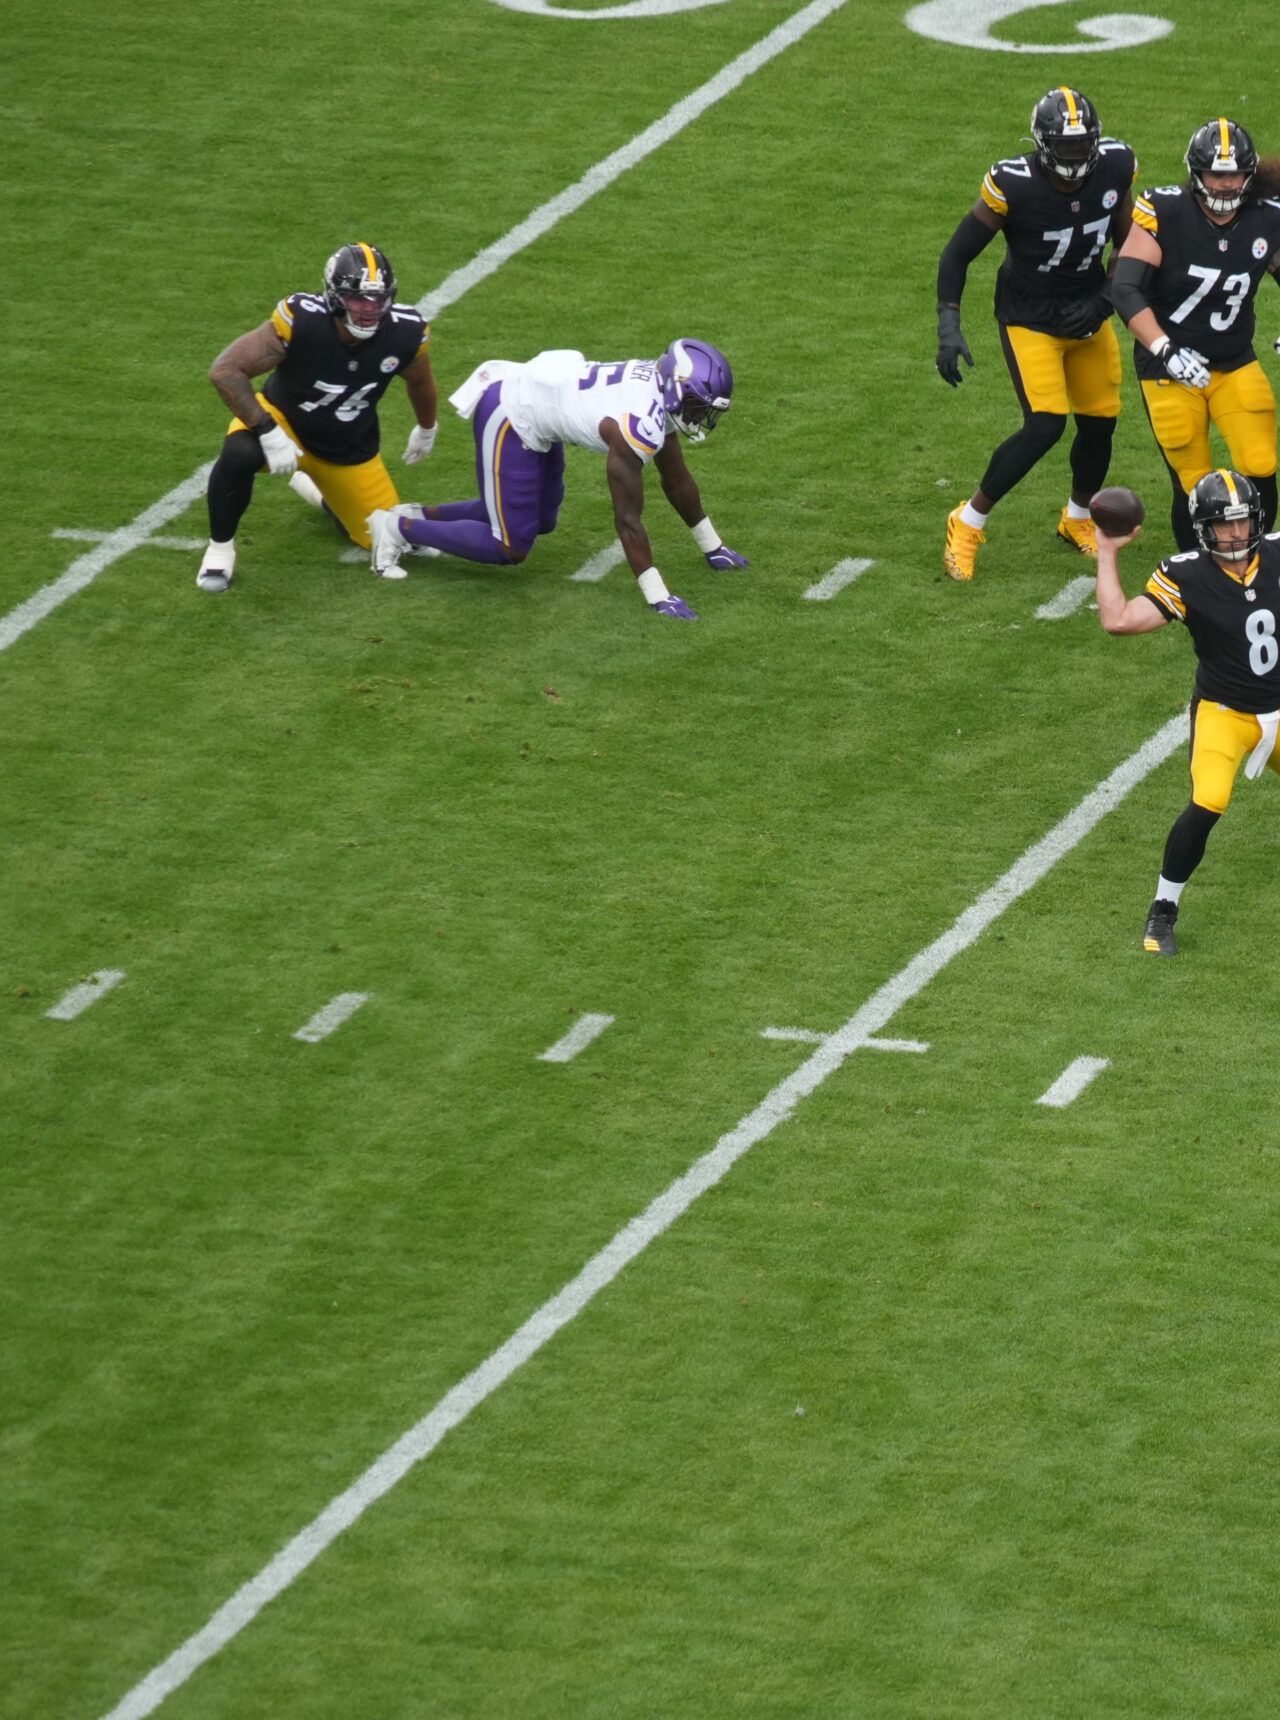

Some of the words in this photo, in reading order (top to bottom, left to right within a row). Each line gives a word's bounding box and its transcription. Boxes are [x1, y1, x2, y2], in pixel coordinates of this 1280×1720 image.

[1155, 185, 1182, 196] 3
[1037, 214, 1111, 273] 77
[1169, 264, 1251, 332] 73
[299, 380, 379, 422] 76
[1170, 551, 1200, 562] 8
[1245, 608, 1279, 676] 8
